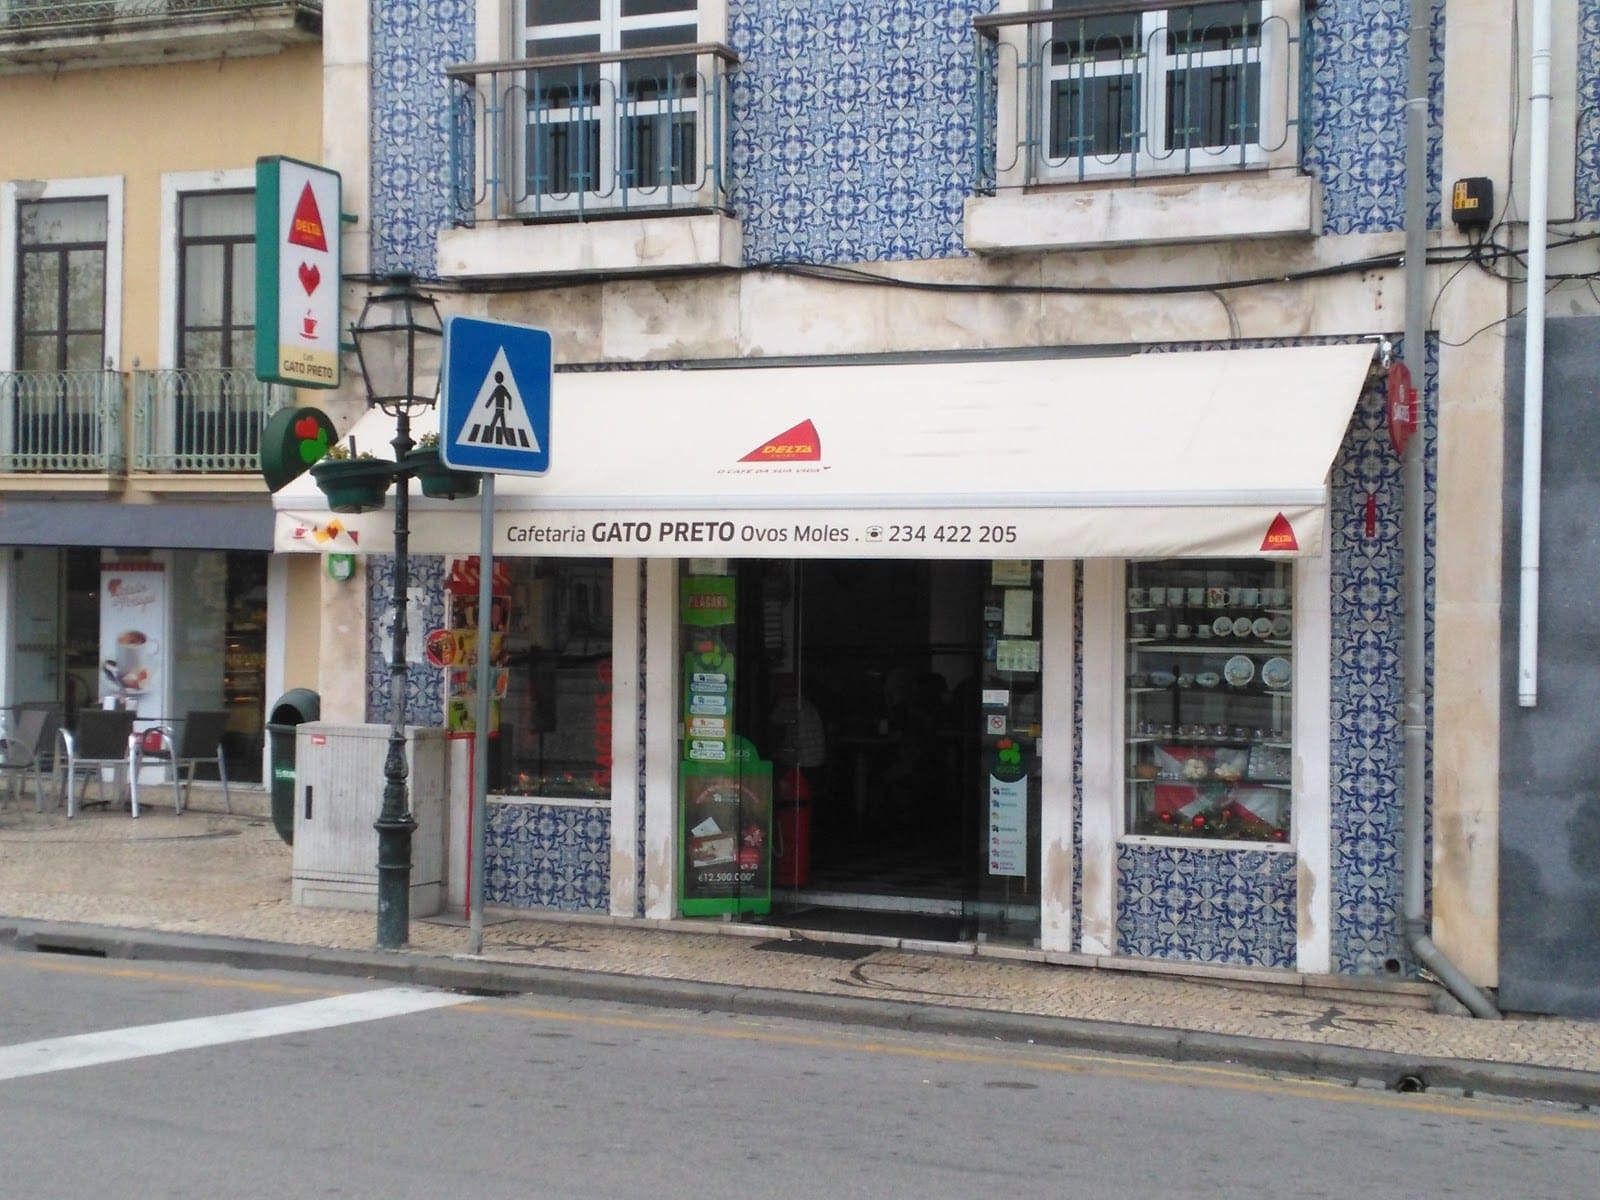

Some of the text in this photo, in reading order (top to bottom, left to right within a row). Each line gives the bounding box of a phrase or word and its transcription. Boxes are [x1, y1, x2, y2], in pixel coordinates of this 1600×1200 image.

[295, 219, 321, 236] DELTA
[283, 360, 333, 378] GATO PRETO
[762, 445, 812, 454] DELTA
[506, 525, 585, 542] Cafetaria
[592, 522, 651, 542] GATO
[659, 521, 735, 542] PRETO
[741, 525, 788, 542] Ovos
[794, 524, 849, 542] Moles
[888, 525, 926, 543] 234
[933, 525, 971, 543] 422
[978, 525, 1017, 543] 205
